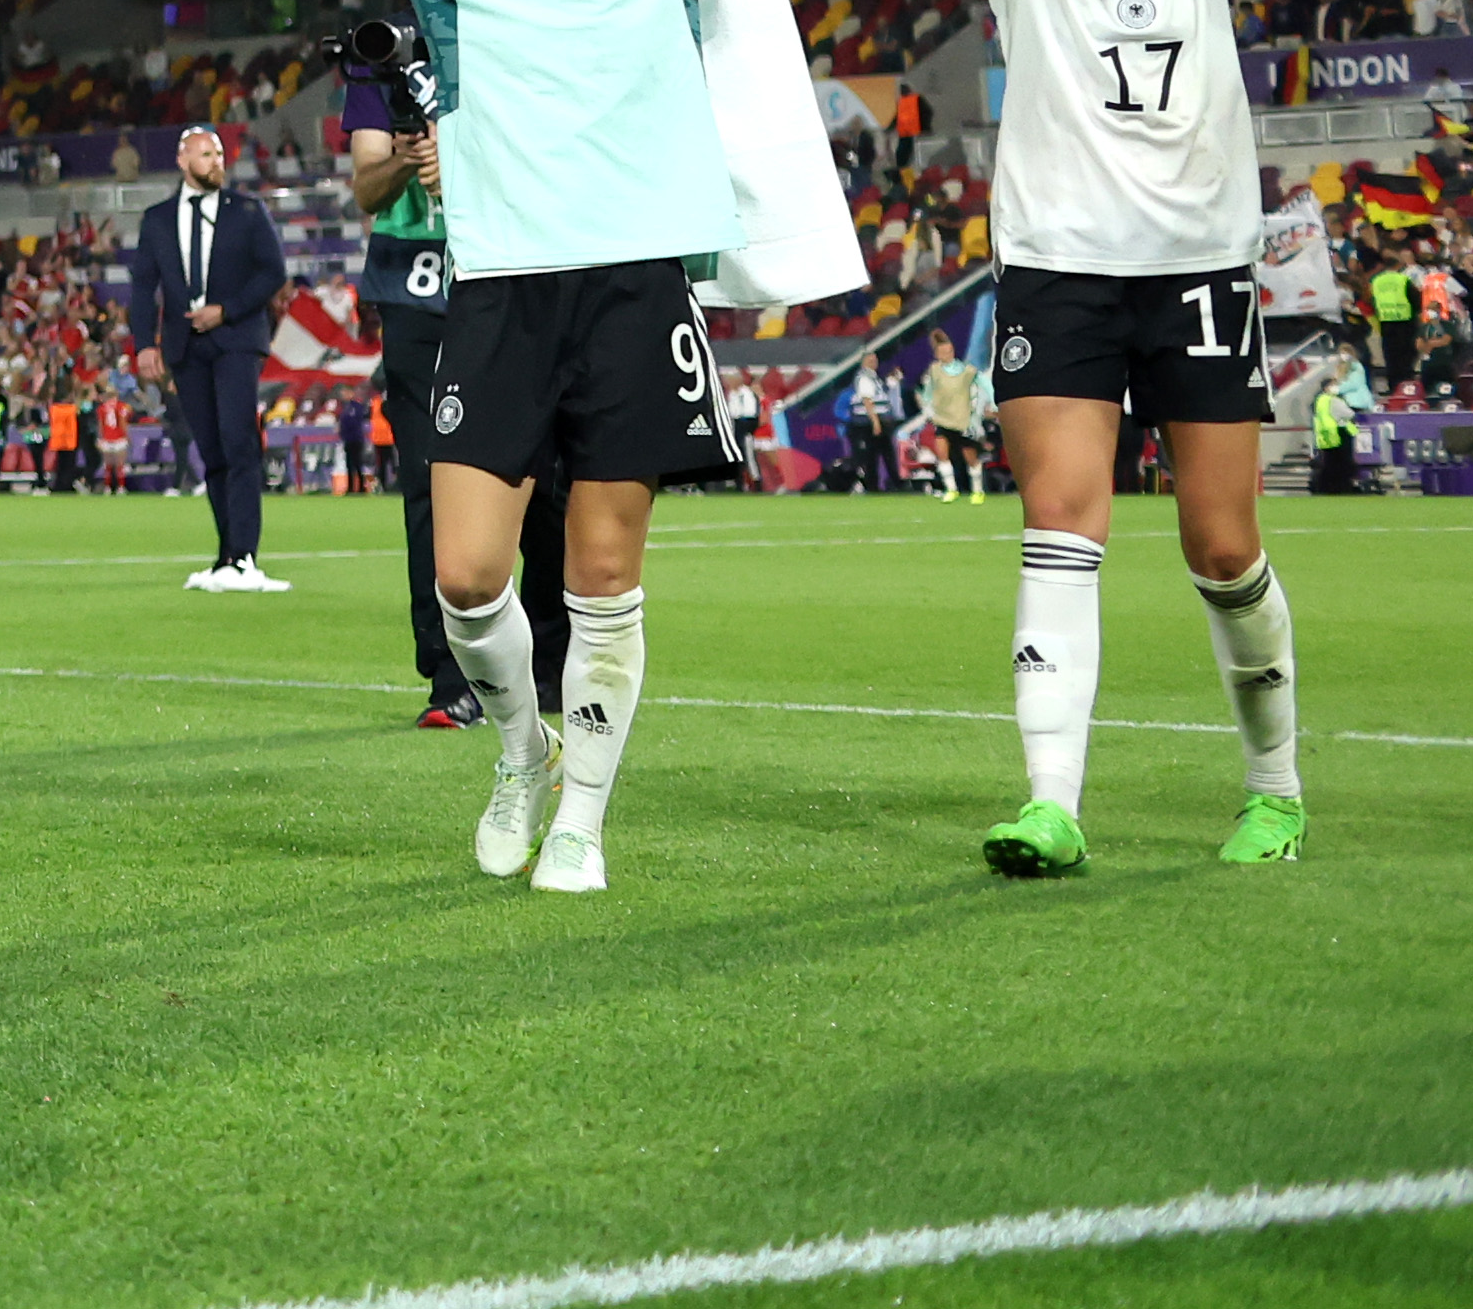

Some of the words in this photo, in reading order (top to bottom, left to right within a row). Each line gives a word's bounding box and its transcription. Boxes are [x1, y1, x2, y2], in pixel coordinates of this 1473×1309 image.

[1098, 40, 1184, 113] 17
[1268, 53, 1411, 87] LNDON
[406, 251, 442, 297] 8
[1181, 281, 1256, 357] 17
[671, 323, 706, 402] 9
